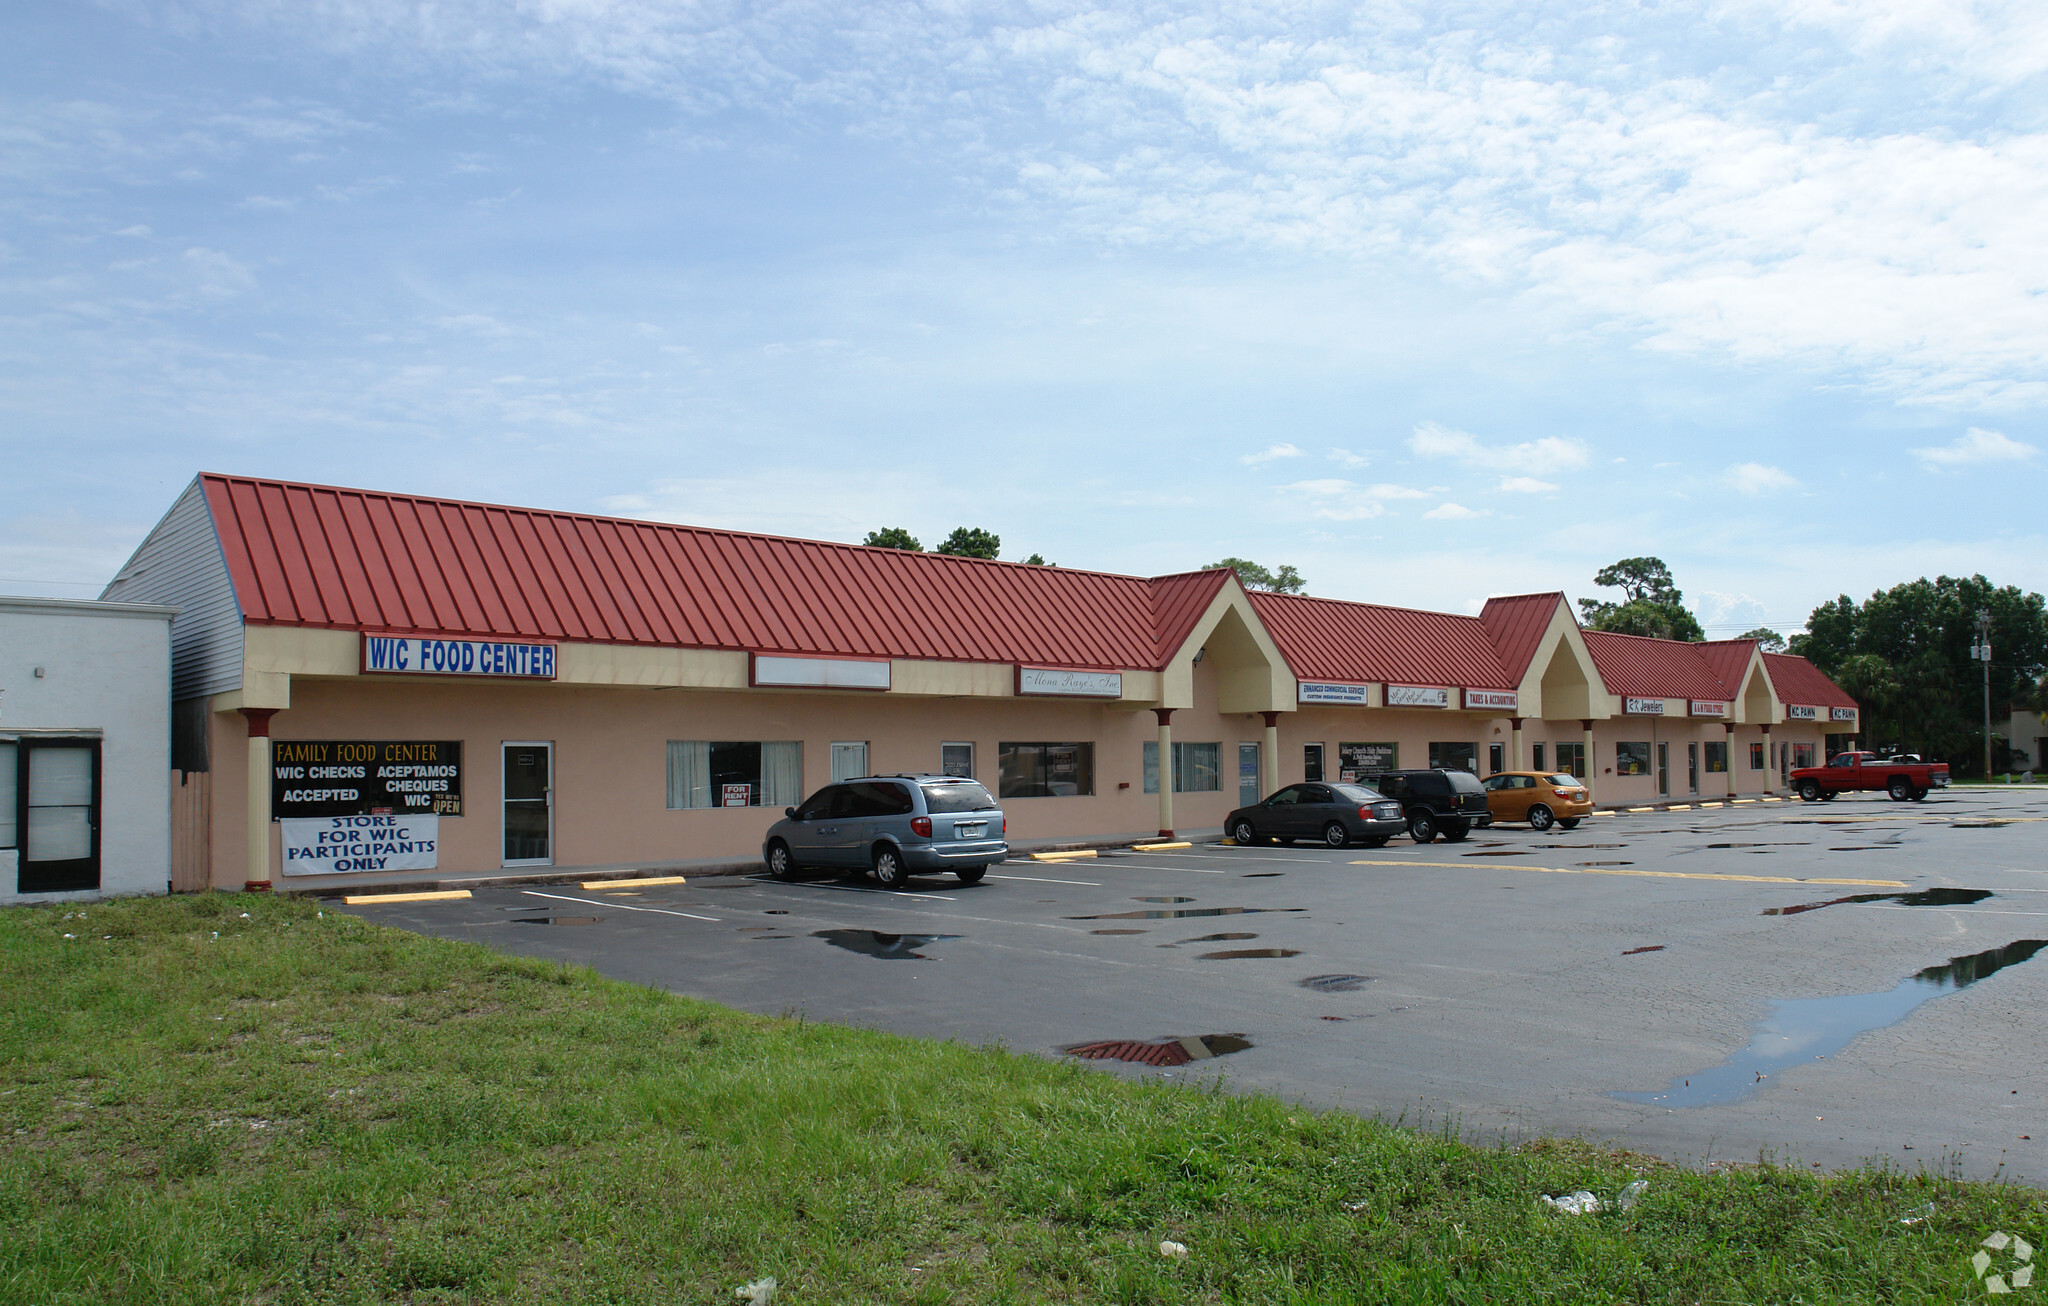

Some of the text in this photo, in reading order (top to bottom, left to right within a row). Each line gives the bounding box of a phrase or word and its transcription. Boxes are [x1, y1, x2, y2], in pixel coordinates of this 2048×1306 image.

[371, 638, 553, 675] WIC FOOD CENTER
[1026, 672, 1057, 685] Mona
[1469, 693, 1483, 704] TAXES
[1489, 694, 1516, 706] ACCOUNTING
[1640, 699, 1664, 712] Jewelers
[1791, 706, 1816, 717] KC PAWN
[1834, 708, 1856, 719] KC PAWN
[277, 744, 437, 762] FAMILY FOOD CENTER
[276, 766, 366, 779] WIC CHECKS
[377, 765, 457, 778] ACEPTAMOS
[386, 779, 448, 793] CHEQUES
[282, 789, 359, 803] ACCEPTED
[404, 794, 430, 807] WIC
[433, 800, 460, 813] OPEN
[332, 816, 397, 828] STORE
[318, 828, 409, 844] FOR WIC
[288, 841, 435, 860] PARTICIPANTS
[334, 857, 388, 872] ONLY
